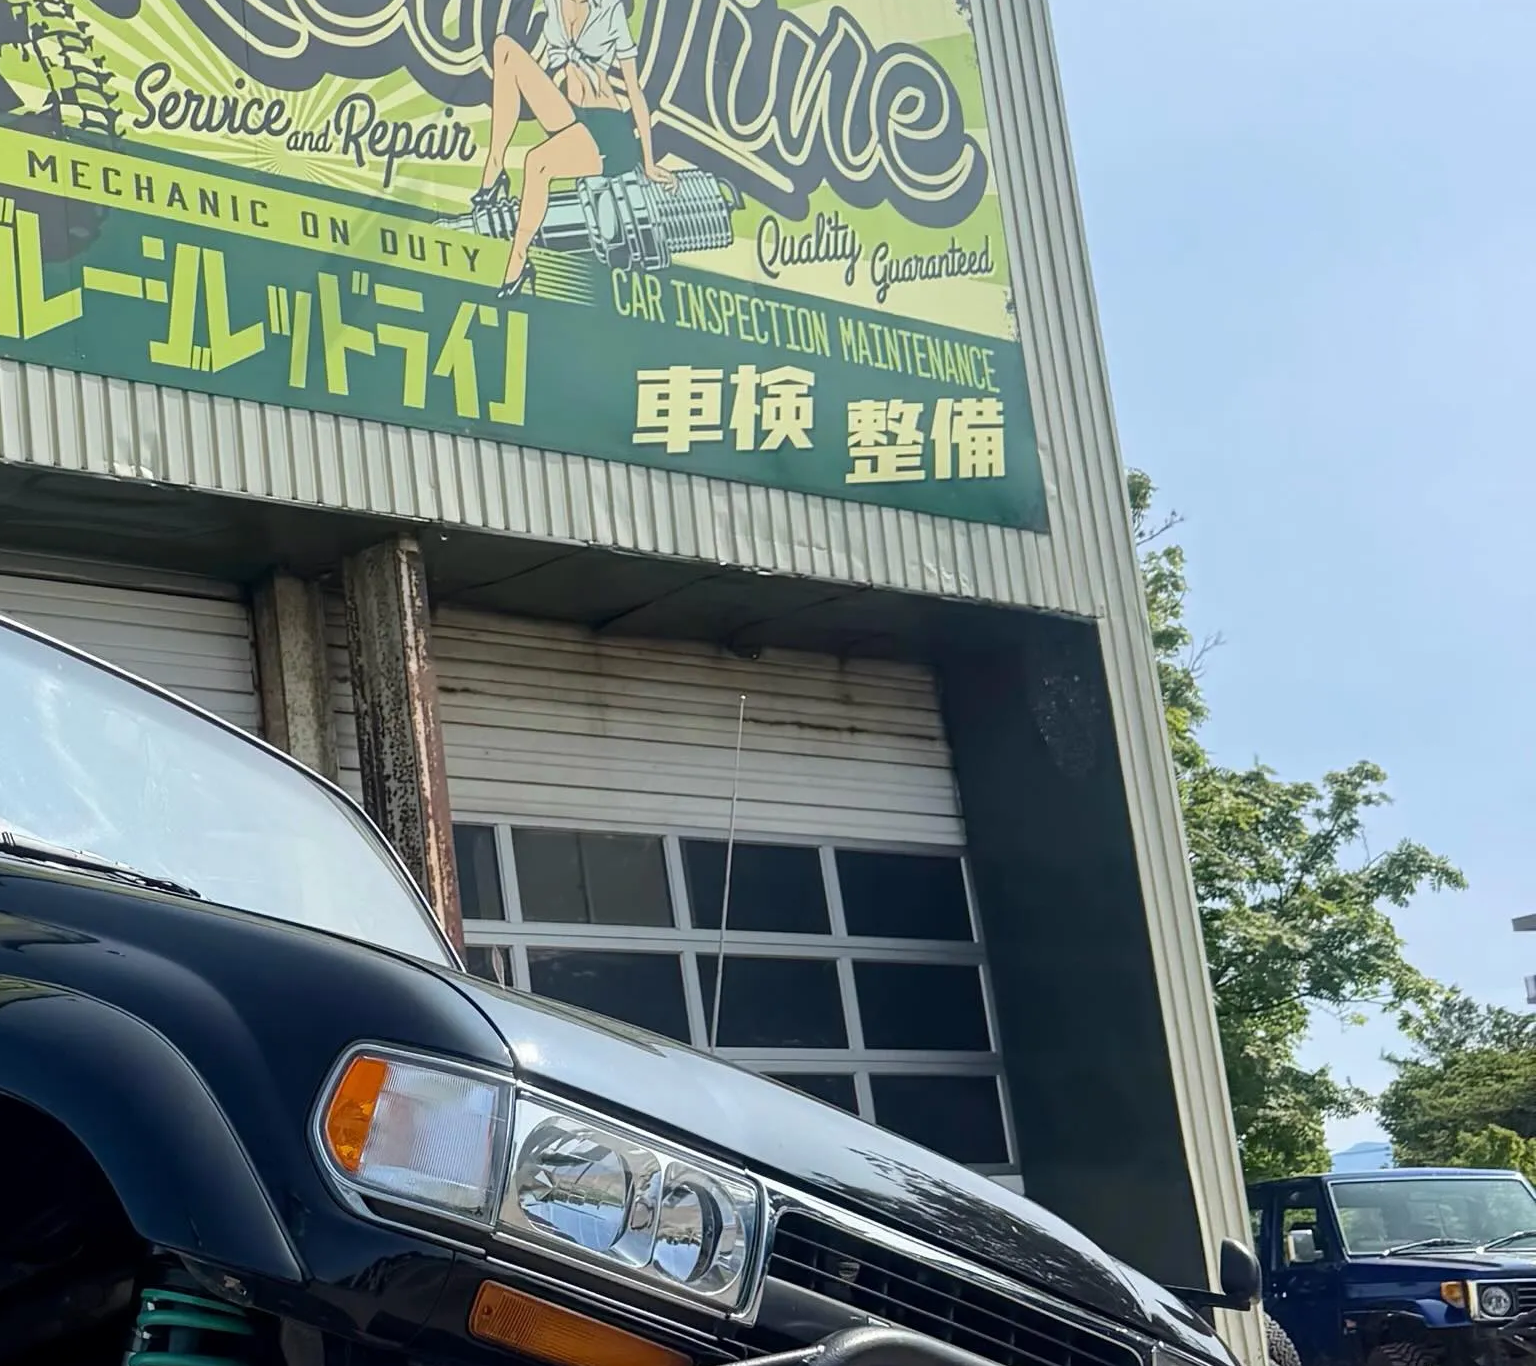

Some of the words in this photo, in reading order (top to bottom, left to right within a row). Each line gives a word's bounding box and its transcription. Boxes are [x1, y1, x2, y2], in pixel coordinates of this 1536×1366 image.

[133, 62, 290, 137] Service
[286, 126, 334, 153] and
[333, 95, 477, 188] Repair
[27, 150, 270, 228] MECHANIC
[301, 210, 351, 247] ON
[380, 228, 482, 272] DUTY
[756, 211, 862, 286] Quality
[870, 236, 995, 303] Guaranteed
[611, 265, 665, 324] CAR
[670, 278, 831, 358] INSPECTION
[838, 317, 1000, 393] MAINTENANCE
[632, 364, 816, 453] 車検
[845, 397, 1006, 483] 整備
